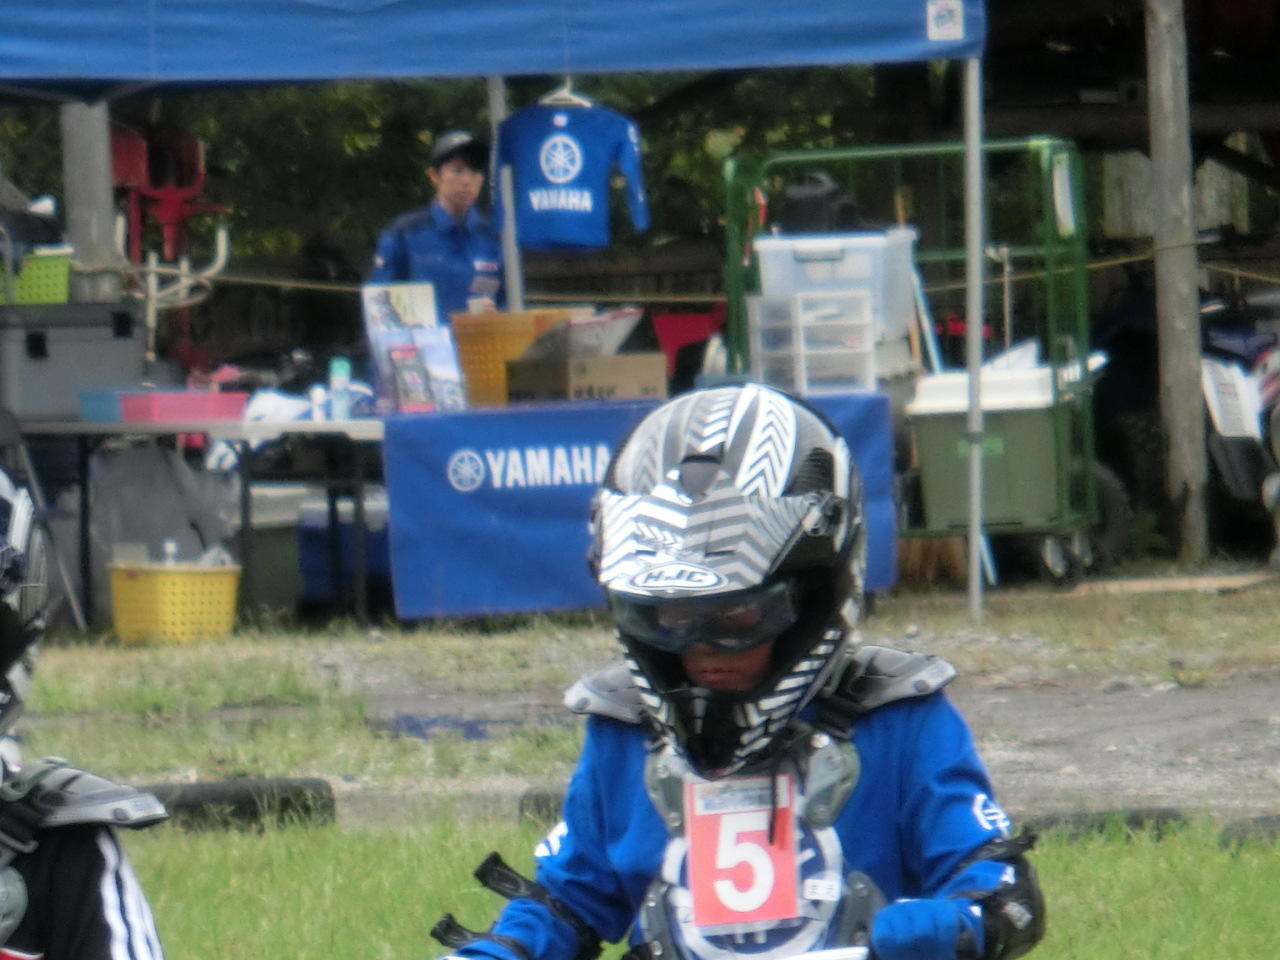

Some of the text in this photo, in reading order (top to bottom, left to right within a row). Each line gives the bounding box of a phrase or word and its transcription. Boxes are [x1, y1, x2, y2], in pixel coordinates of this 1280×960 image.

[529, 189, 592, 211] YAMAHA
[485, 446, 611, 488] YAMAHA
[642, 568, 709, 584] HJC
[714, 812, 775, 912] 5
